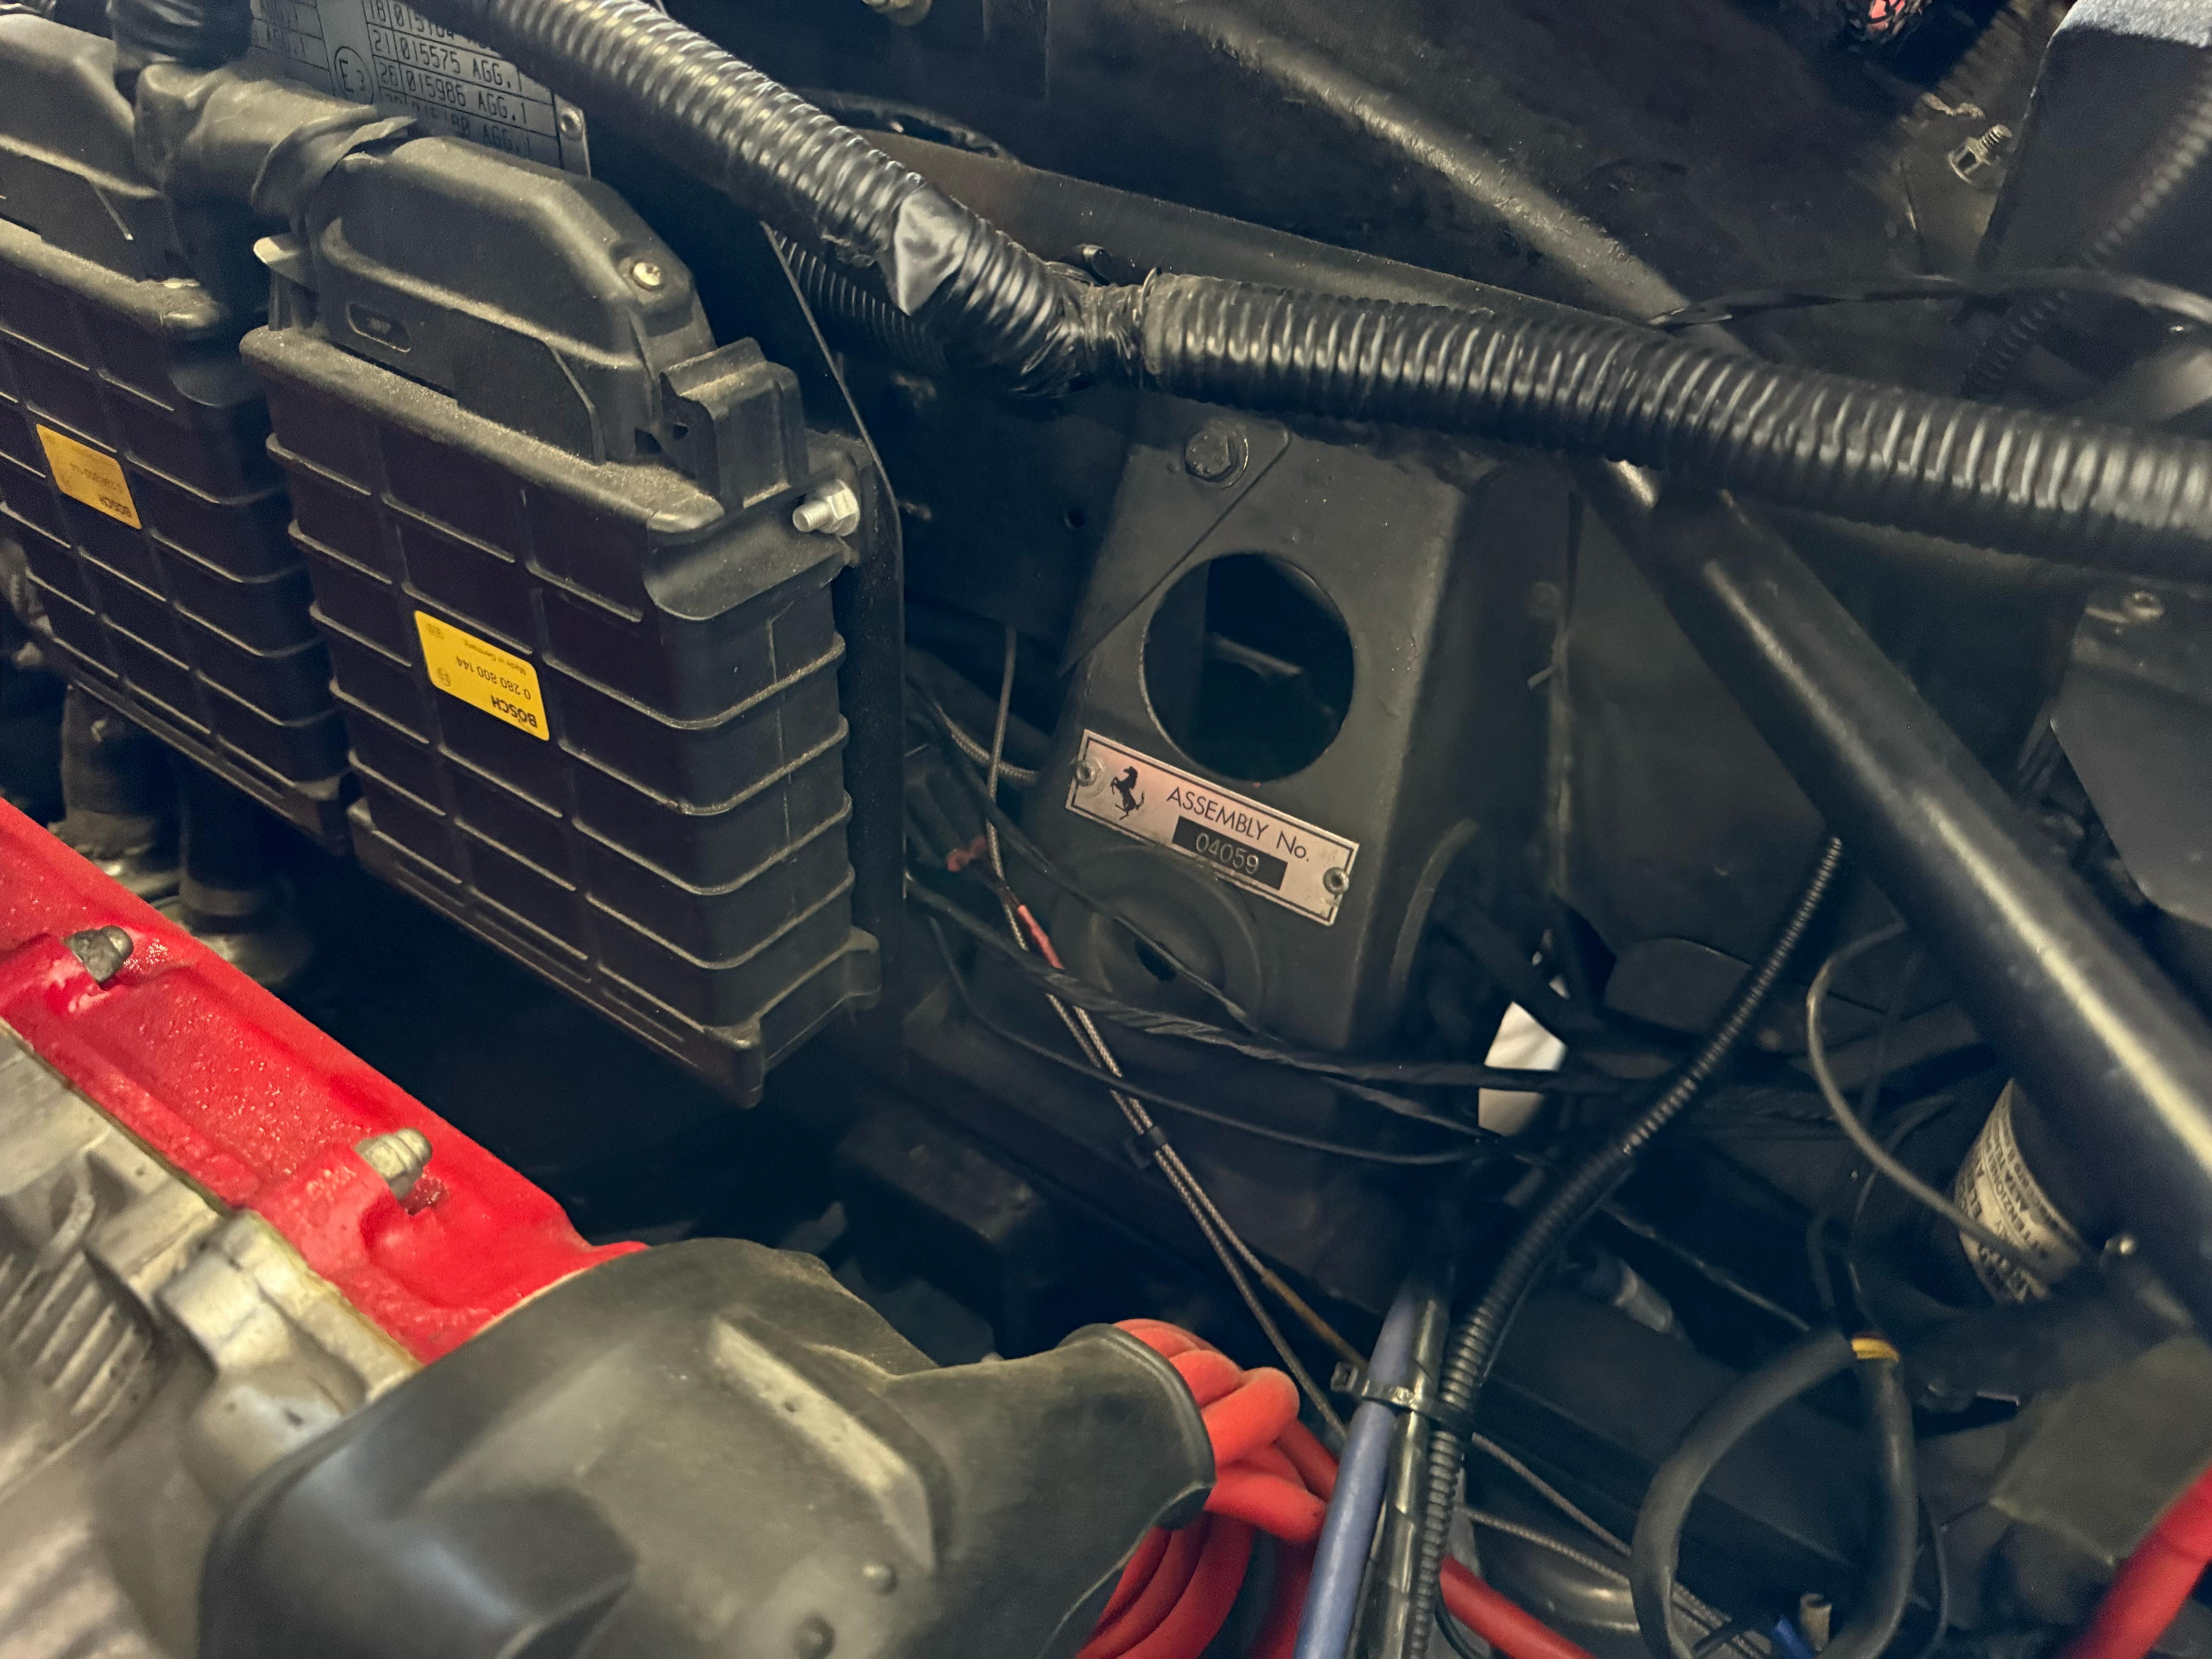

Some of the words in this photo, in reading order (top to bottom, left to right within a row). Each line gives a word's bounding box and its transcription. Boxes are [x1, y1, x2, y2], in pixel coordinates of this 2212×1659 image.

[372, 29, 391, 54] 21
[400, 38, 461, 74] 015575
[380, 63, 398, 86] 26
[406, 70, 466, 107] 015986
[456, 656, 474, 672] 144
[477, 666, 497, 684] 800
[506, 661, 526, 675] Made
[499, 677, 521, 694] 280
[524, 689, 531, 700] 0
[491, 695, 538, 728] BOSCH
[1167, 787, 1269, 841] ASSEMBLY
[1277, 831, 1309, 862] No.
[1195, 832, 1259, 875] 04059
